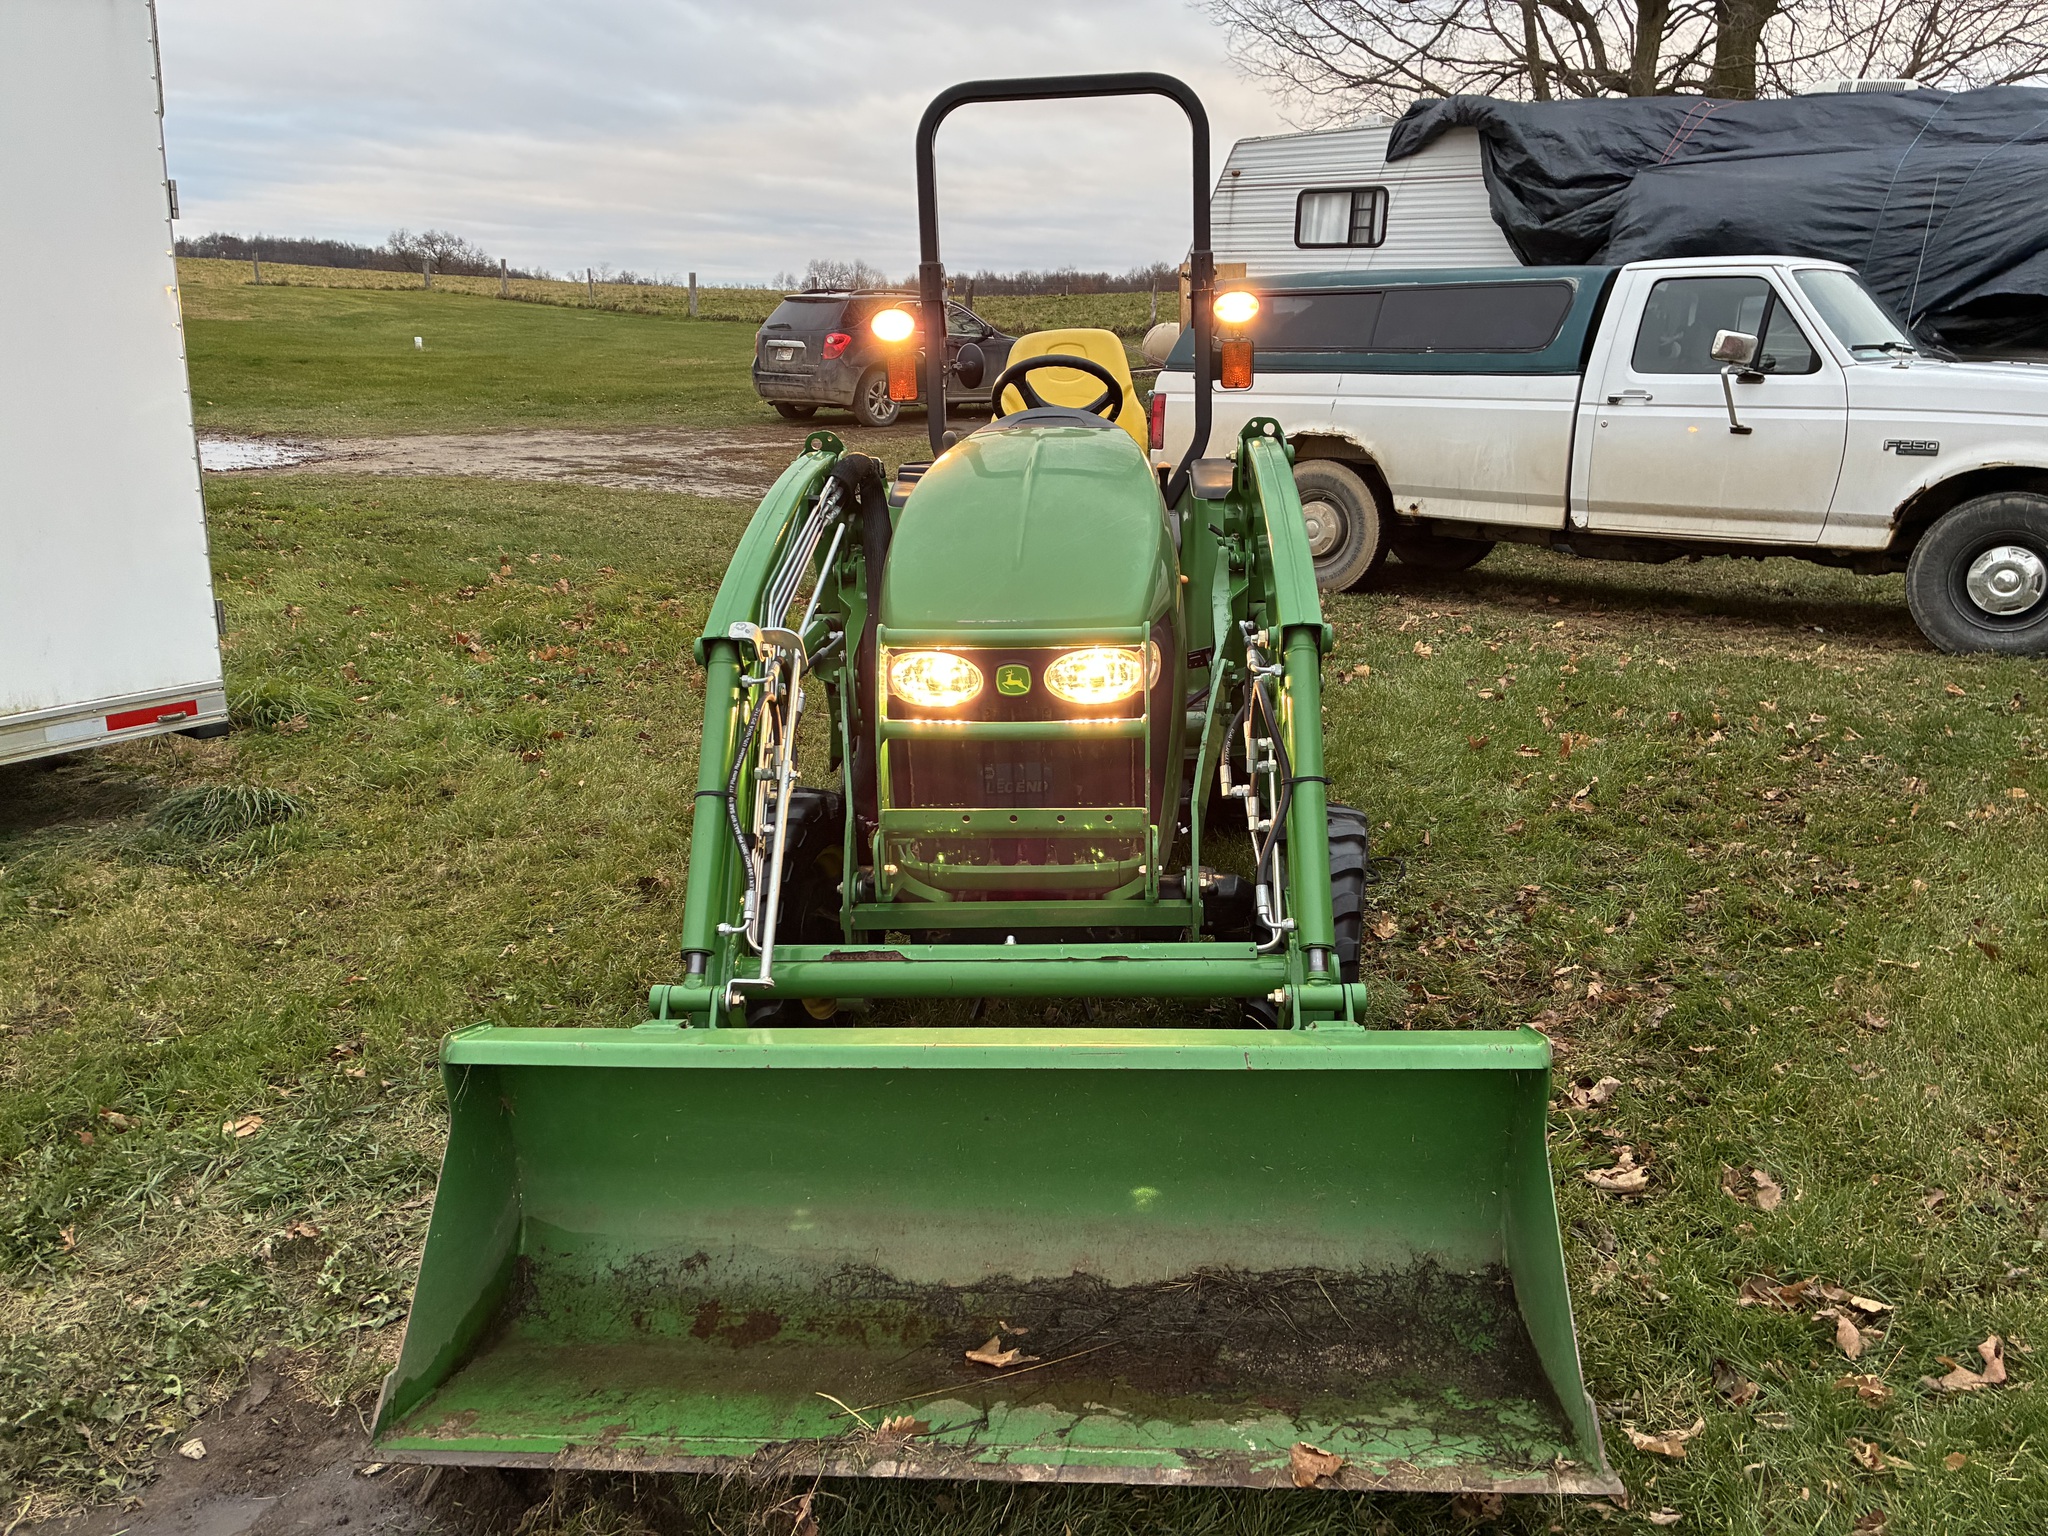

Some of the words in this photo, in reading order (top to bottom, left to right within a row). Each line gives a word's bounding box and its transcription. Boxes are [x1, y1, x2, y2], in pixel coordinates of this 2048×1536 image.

[1883, 439, 1939, 451] F250
[735, 747, 746, 769] Resistant
[730, 770, 738, 784] Flame
[986, 781, 1048, 793] LEGEND
[728, 803, 736, 814] SAE
[732, 822, 741, 835] MAX
[744, 855, 753, 868] INCH
